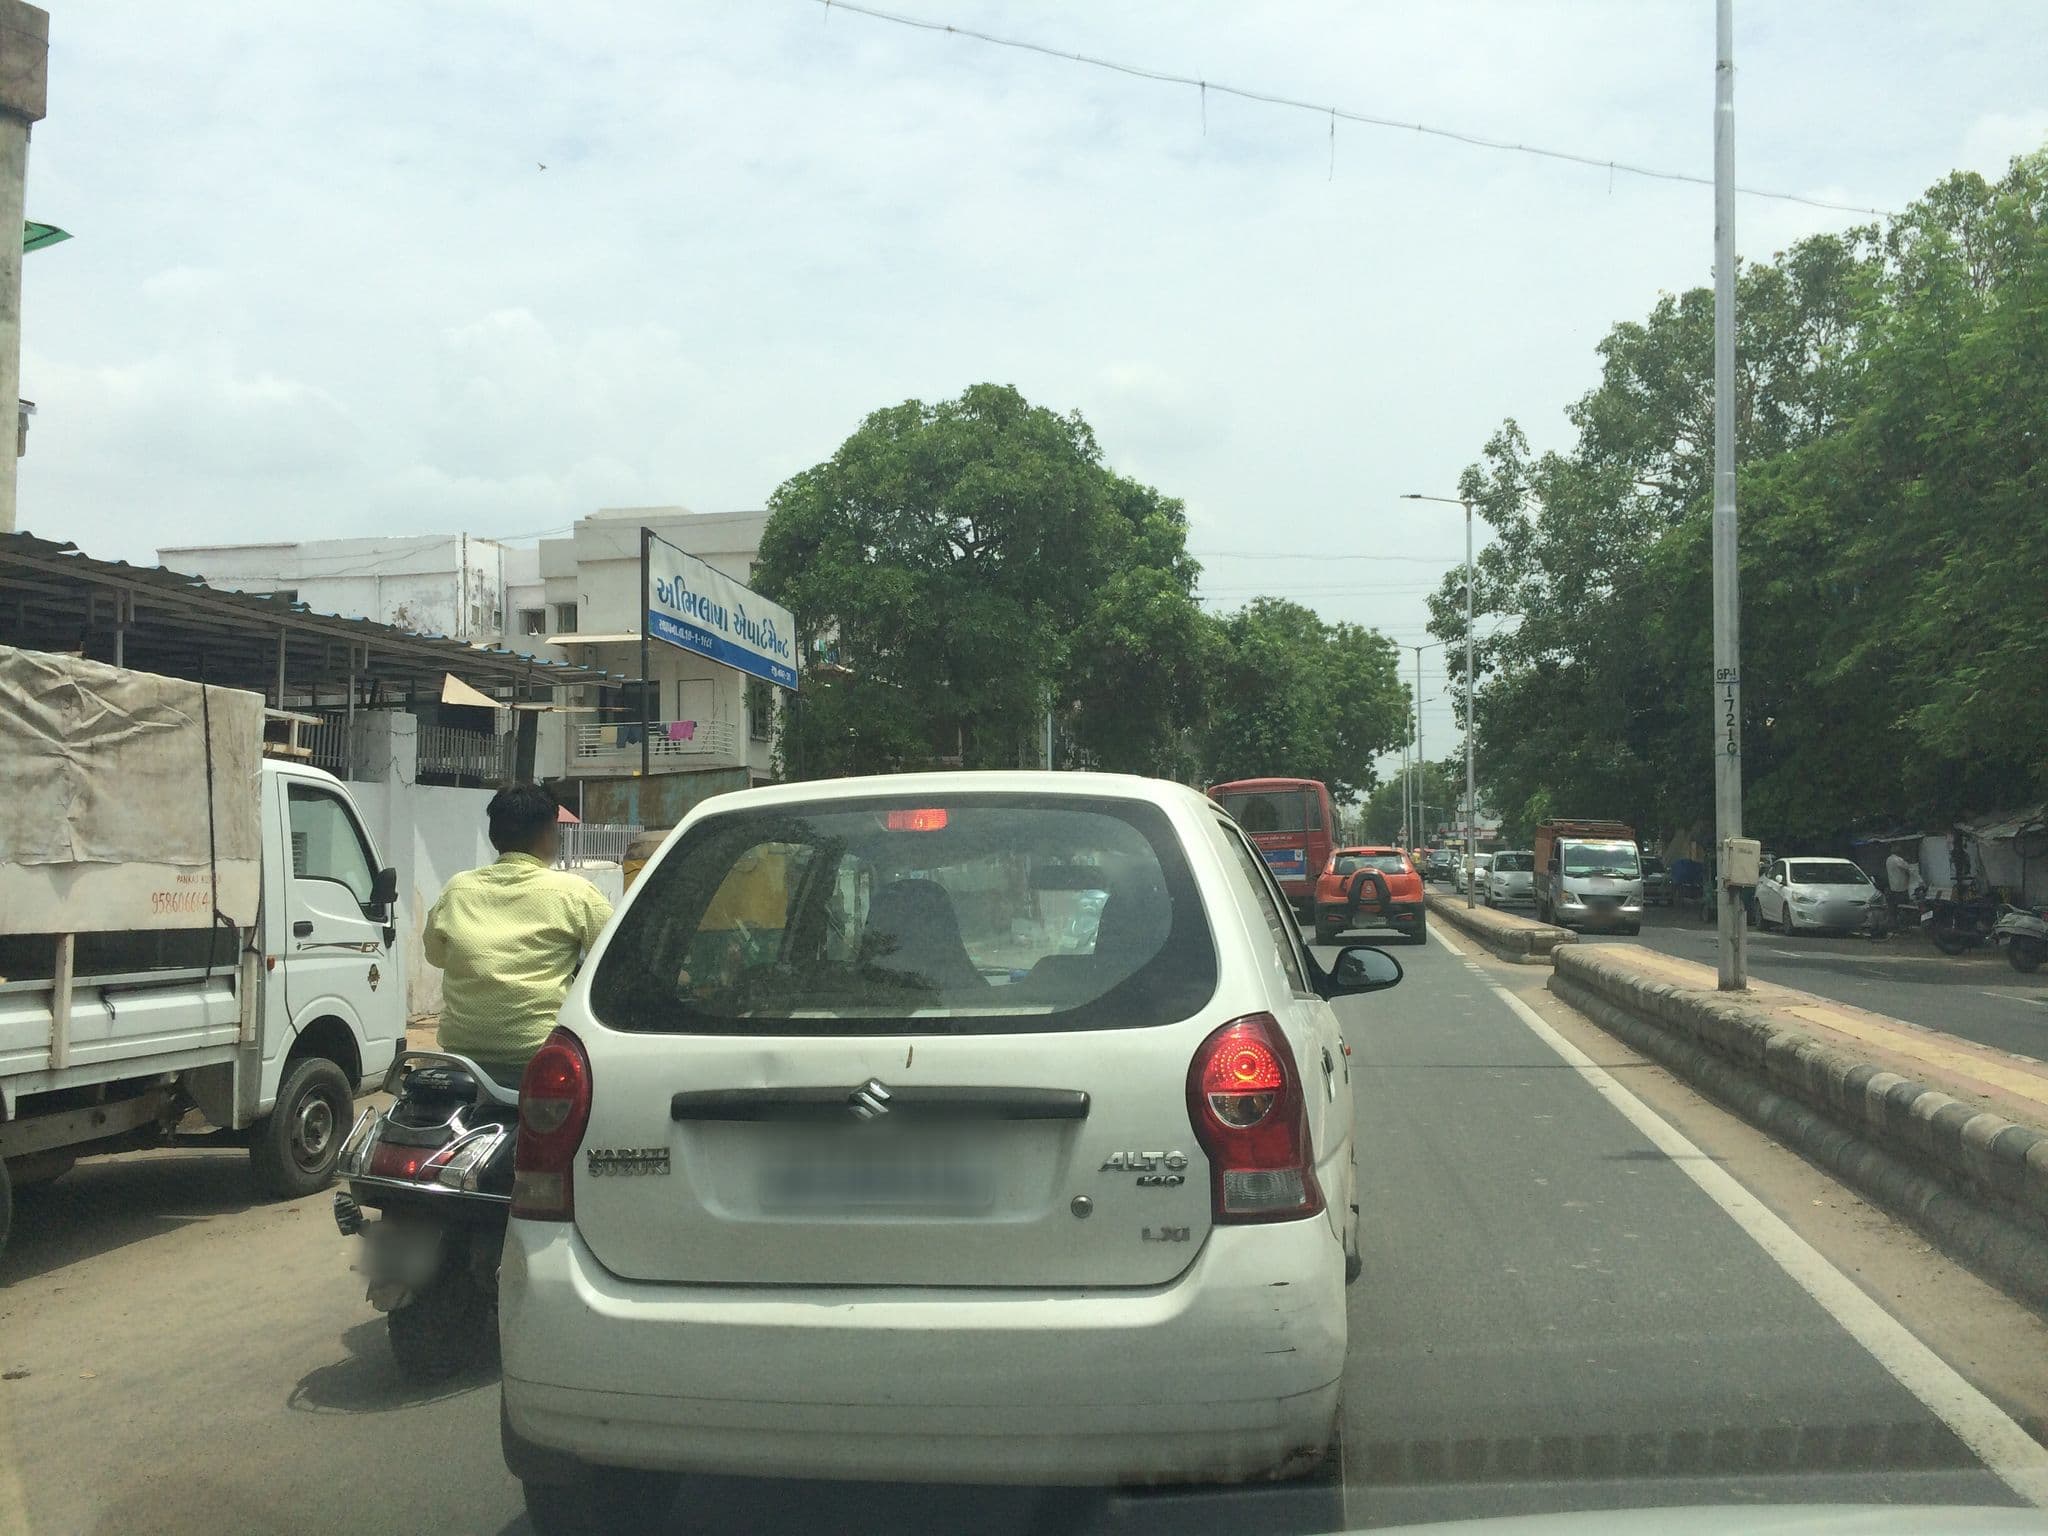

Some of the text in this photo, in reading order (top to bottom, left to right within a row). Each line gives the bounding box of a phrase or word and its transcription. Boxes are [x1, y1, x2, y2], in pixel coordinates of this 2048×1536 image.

[656, 575, 789, 659] અભિલાષા એપાર્ટમેન્ટ
[587, 1147, 670, 1160] MARUTI
[1098, 1150, 1188, 1172] ALTO
[588, 1160, 671, 1178] SUZUKI
